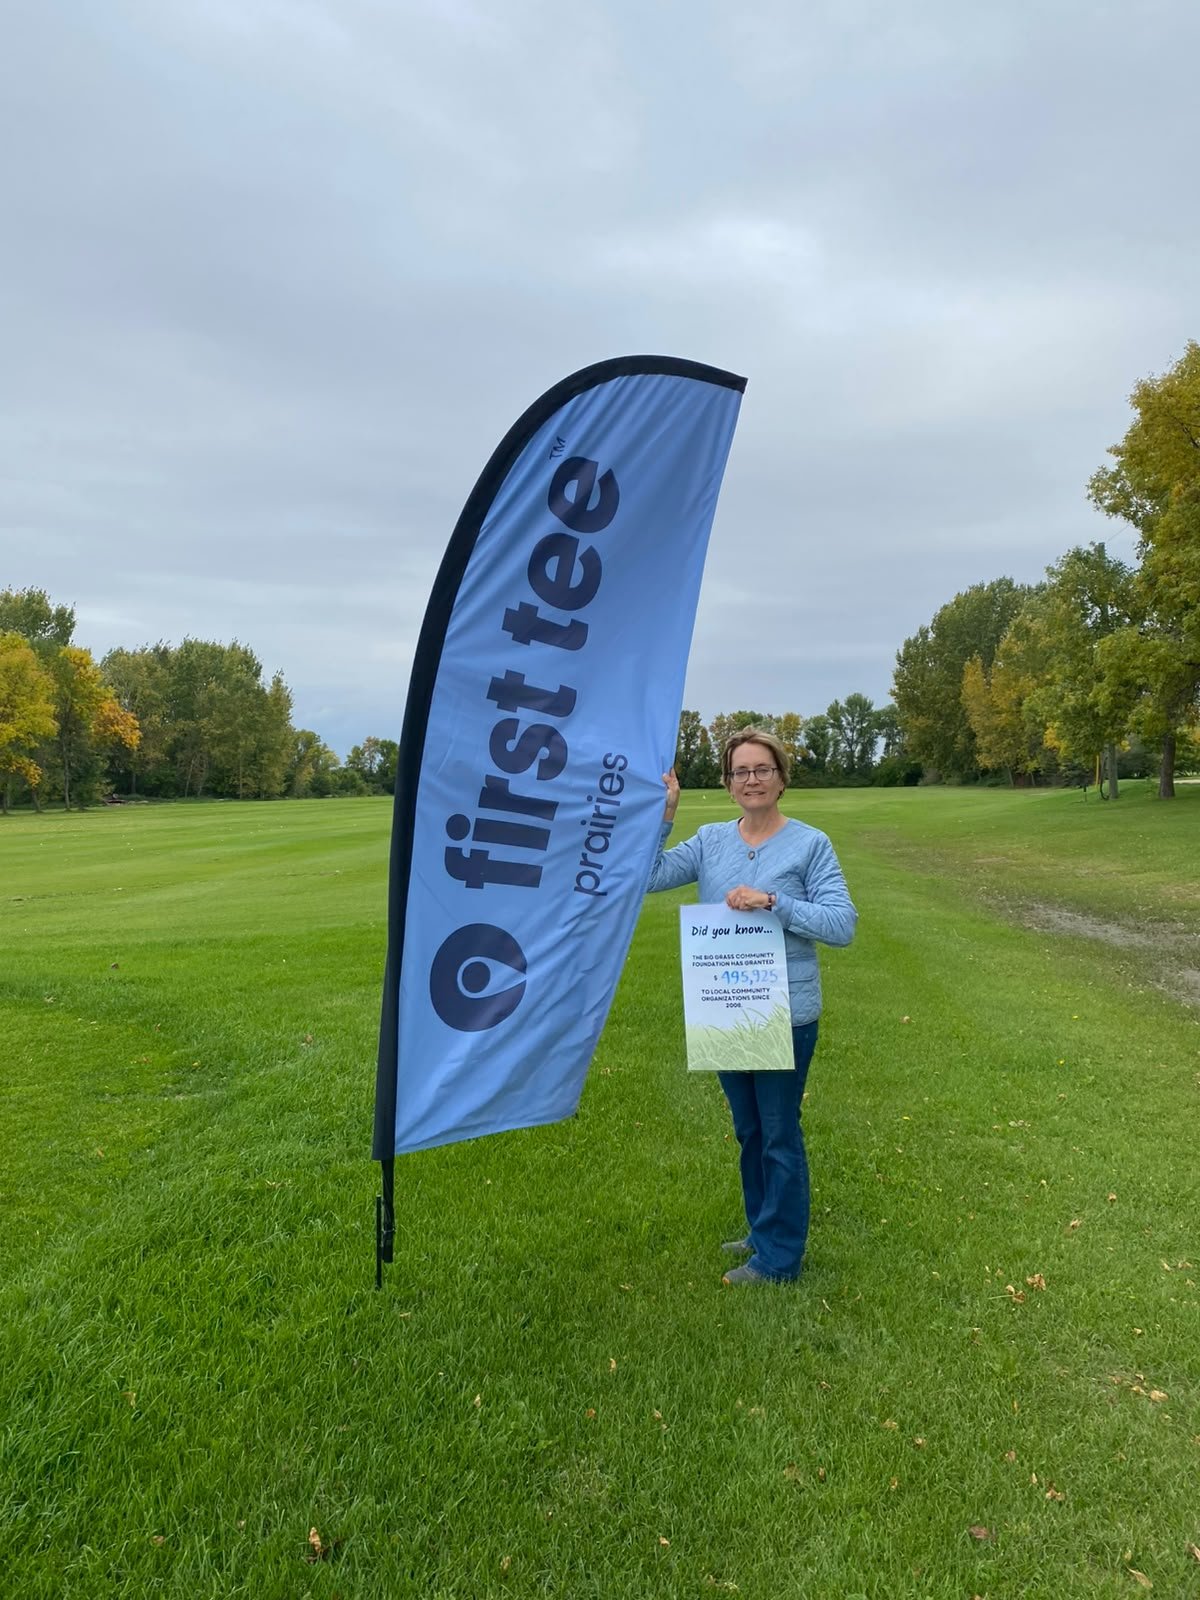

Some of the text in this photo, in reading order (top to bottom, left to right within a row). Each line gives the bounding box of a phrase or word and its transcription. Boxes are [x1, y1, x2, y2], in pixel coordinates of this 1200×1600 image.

[502, 456, 620, 651] tee
[444, 669, 577, 889] first
[574, 752, 628, 897] prairies
[691, 923, 773, 939] Did you know...
